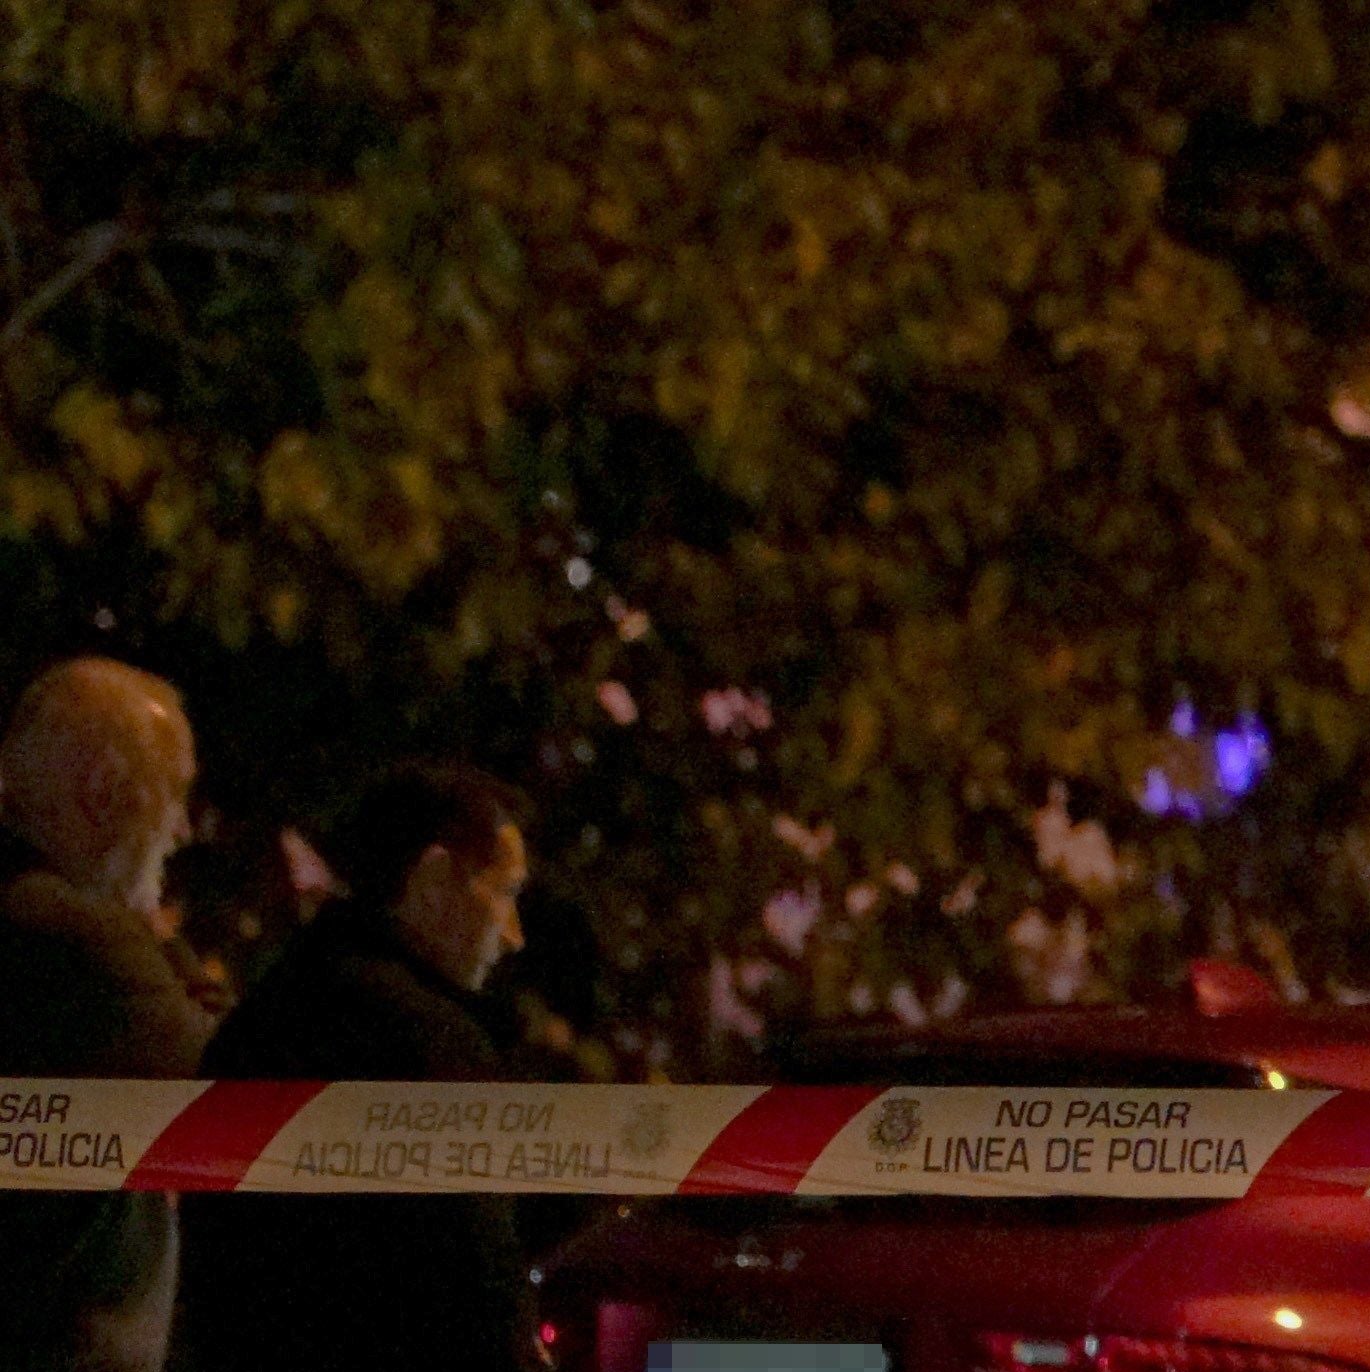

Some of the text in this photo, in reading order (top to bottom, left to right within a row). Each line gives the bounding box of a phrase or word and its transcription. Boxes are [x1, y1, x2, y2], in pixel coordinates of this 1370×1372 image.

[0, 1094, 71, 1124] SAR
[995, 1100, 1192, 1129] NO PASAR
[922, 1136, 1249, 1174] LINEA DE POLICIA
